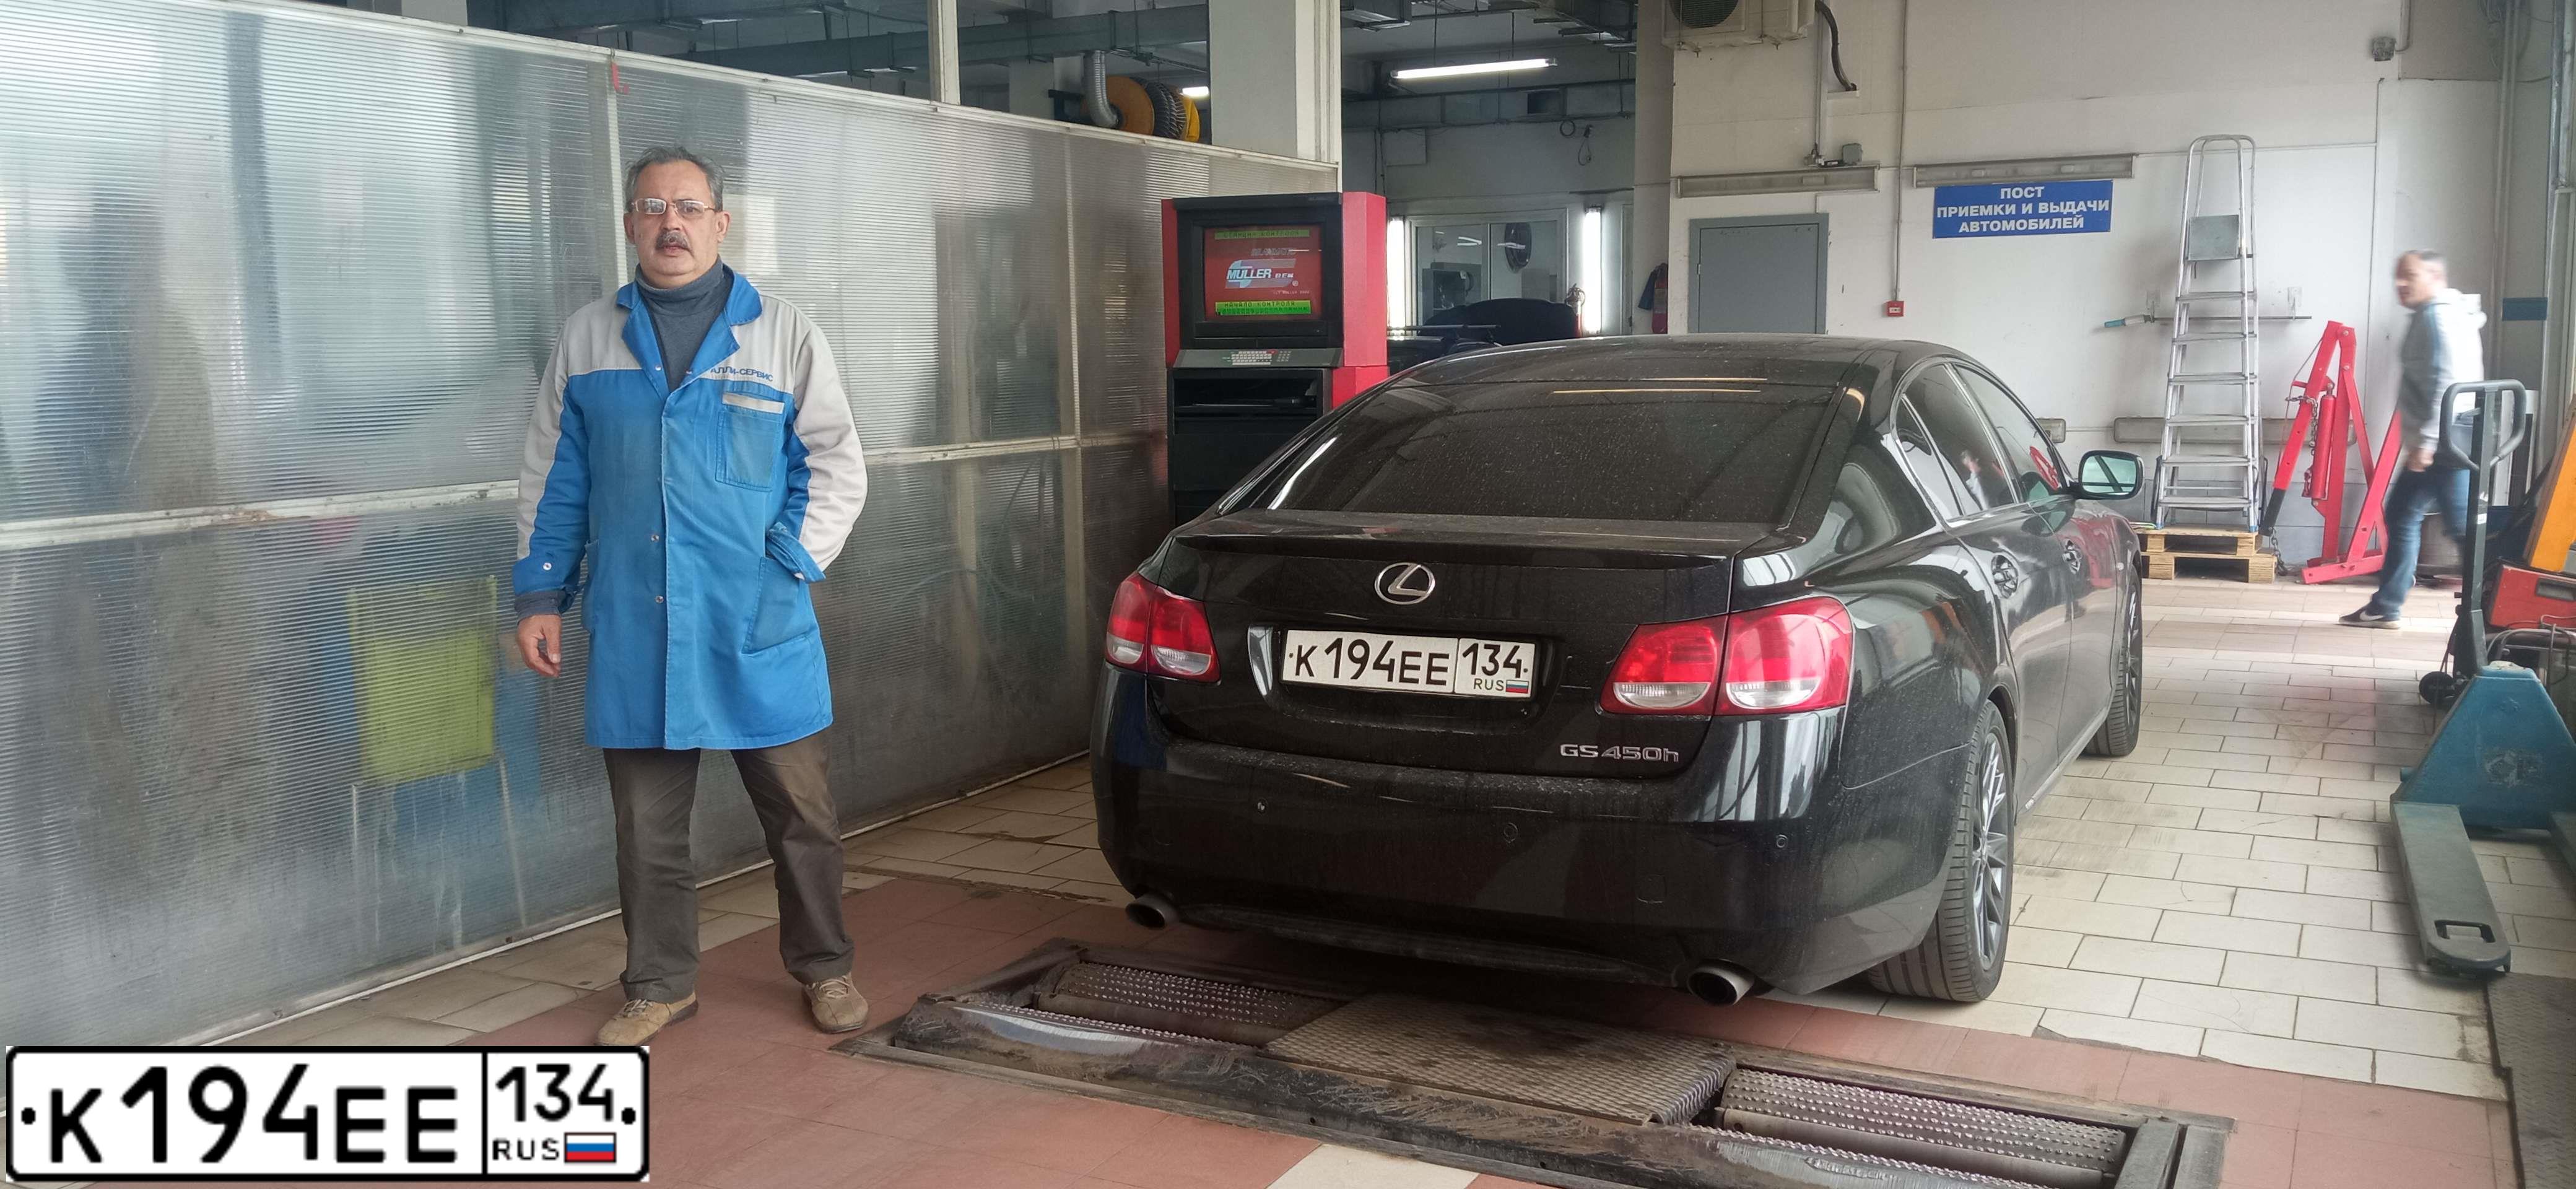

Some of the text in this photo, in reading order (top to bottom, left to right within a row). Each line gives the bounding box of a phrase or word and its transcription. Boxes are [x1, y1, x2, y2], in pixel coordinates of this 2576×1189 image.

[2000, 186, 2045, 199] ПОСТ
[1937, 200, 2110, 217] ПРИЕМКИ И ВЫДАЧИ
[1959, 215, 2084, 233] АВТОМОБИЛЕЙ
[1227, 269, 1272, 279] MULLER
[1462, 643, 1523, 678] 134
[1473, 678, 1504, 690] RUS
